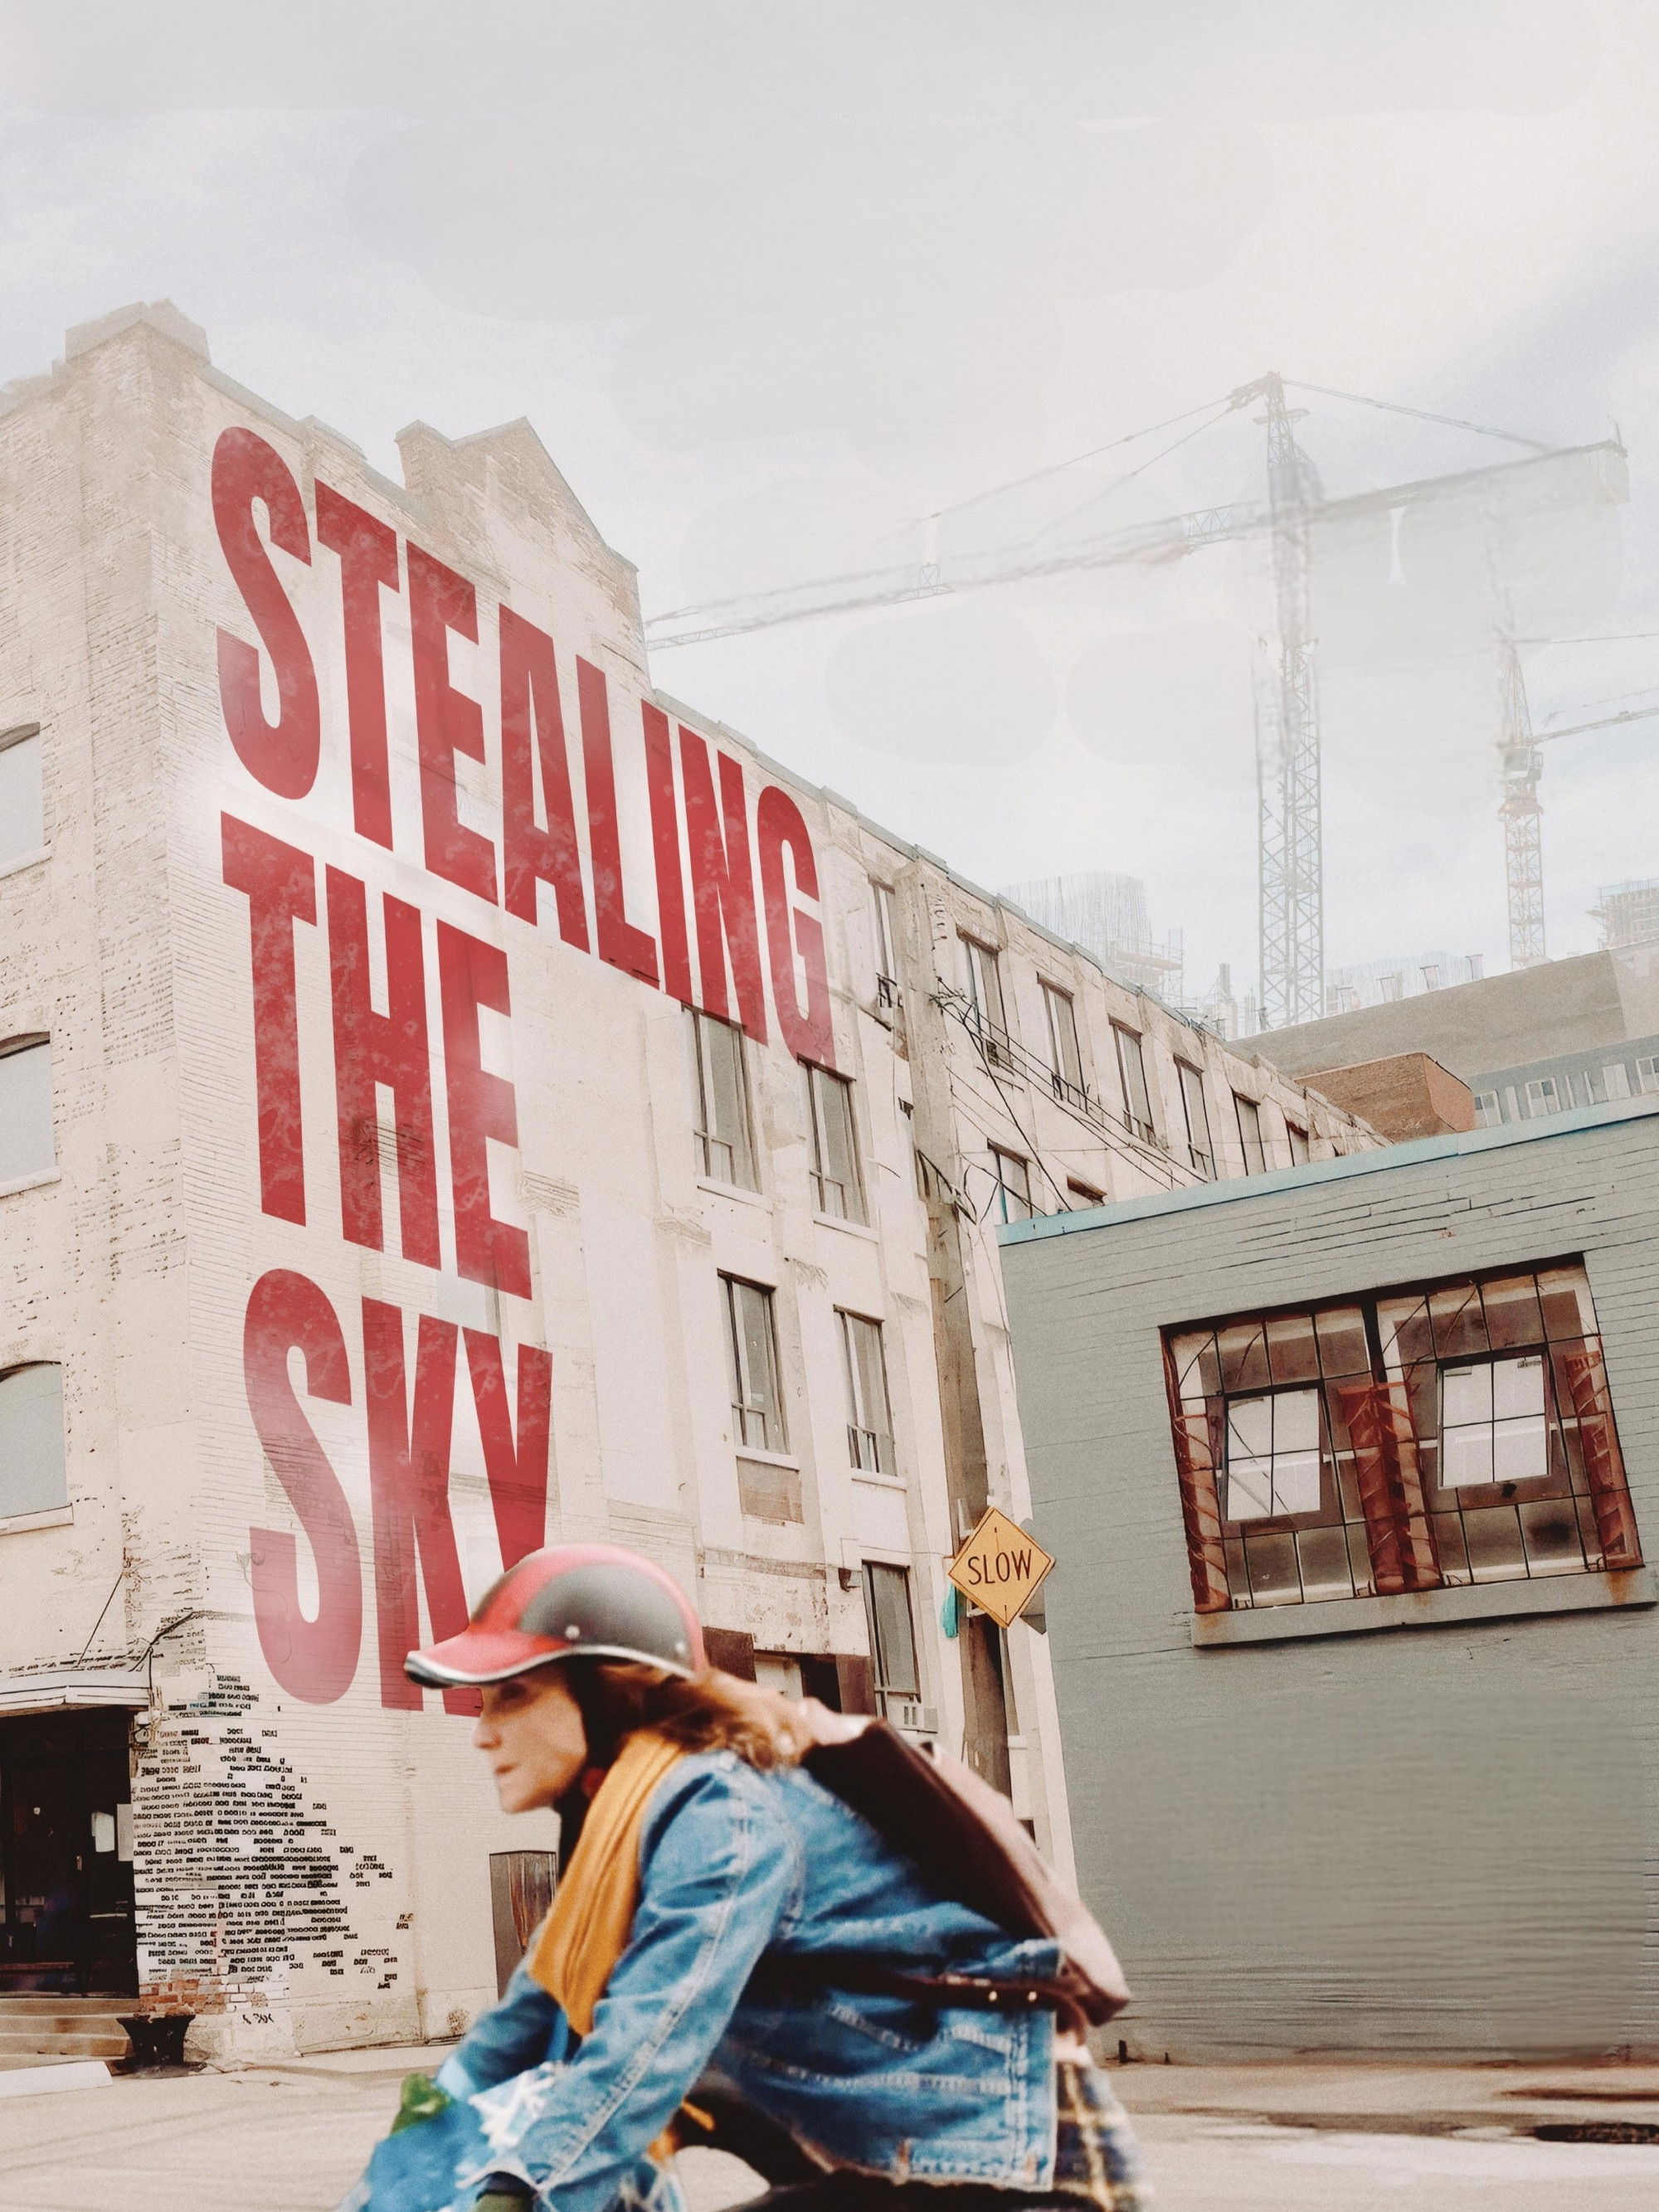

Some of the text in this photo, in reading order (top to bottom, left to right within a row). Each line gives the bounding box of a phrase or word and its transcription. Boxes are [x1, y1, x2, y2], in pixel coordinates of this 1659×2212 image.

[212, 425, 836, 1067] STEALING
[221, 810, 533, 1301] THE
[243, 1268, 553, 1718] SKY
[967, 1548, 1032, 1585] SLOW
